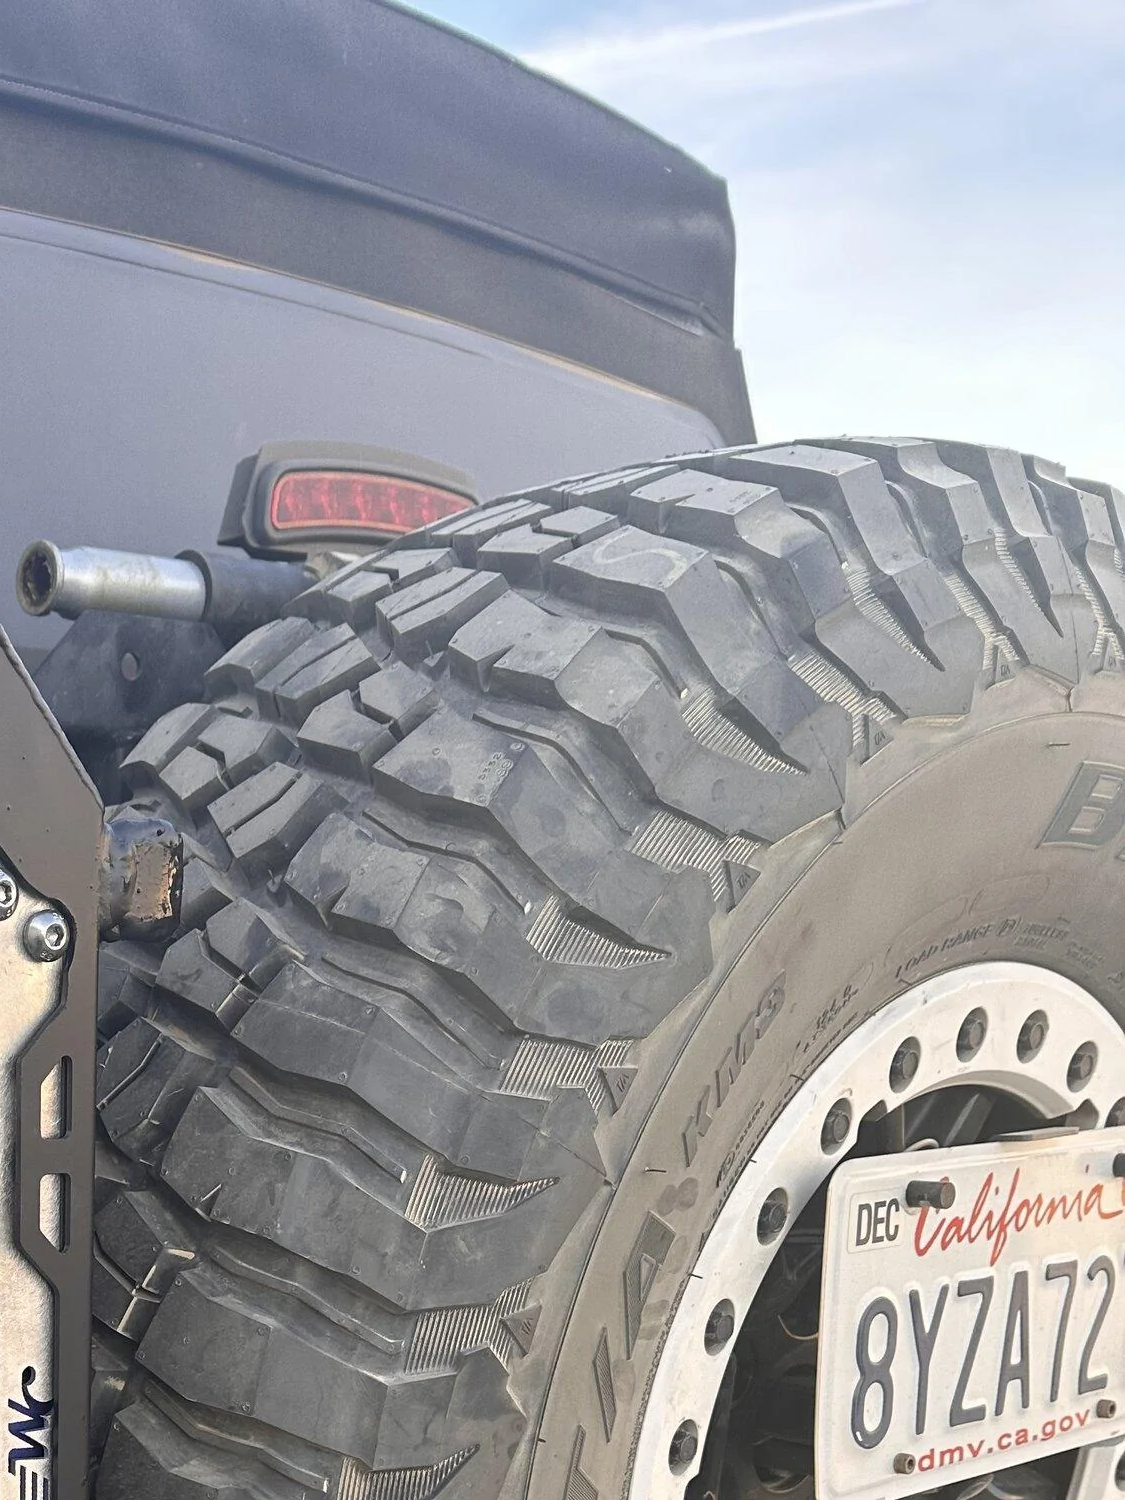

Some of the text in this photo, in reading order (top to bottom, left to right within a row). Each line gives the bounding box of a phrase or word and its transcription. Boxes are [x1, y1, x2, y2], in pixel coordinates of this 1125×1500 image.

[856, 1198, 901, 1247] DEC
[914, 1165, 1122, 1266] California
[851, 1254, 1125, 1450] 8YZA72
[918, 1408, 1091, 1472] dmv.ca.gov
